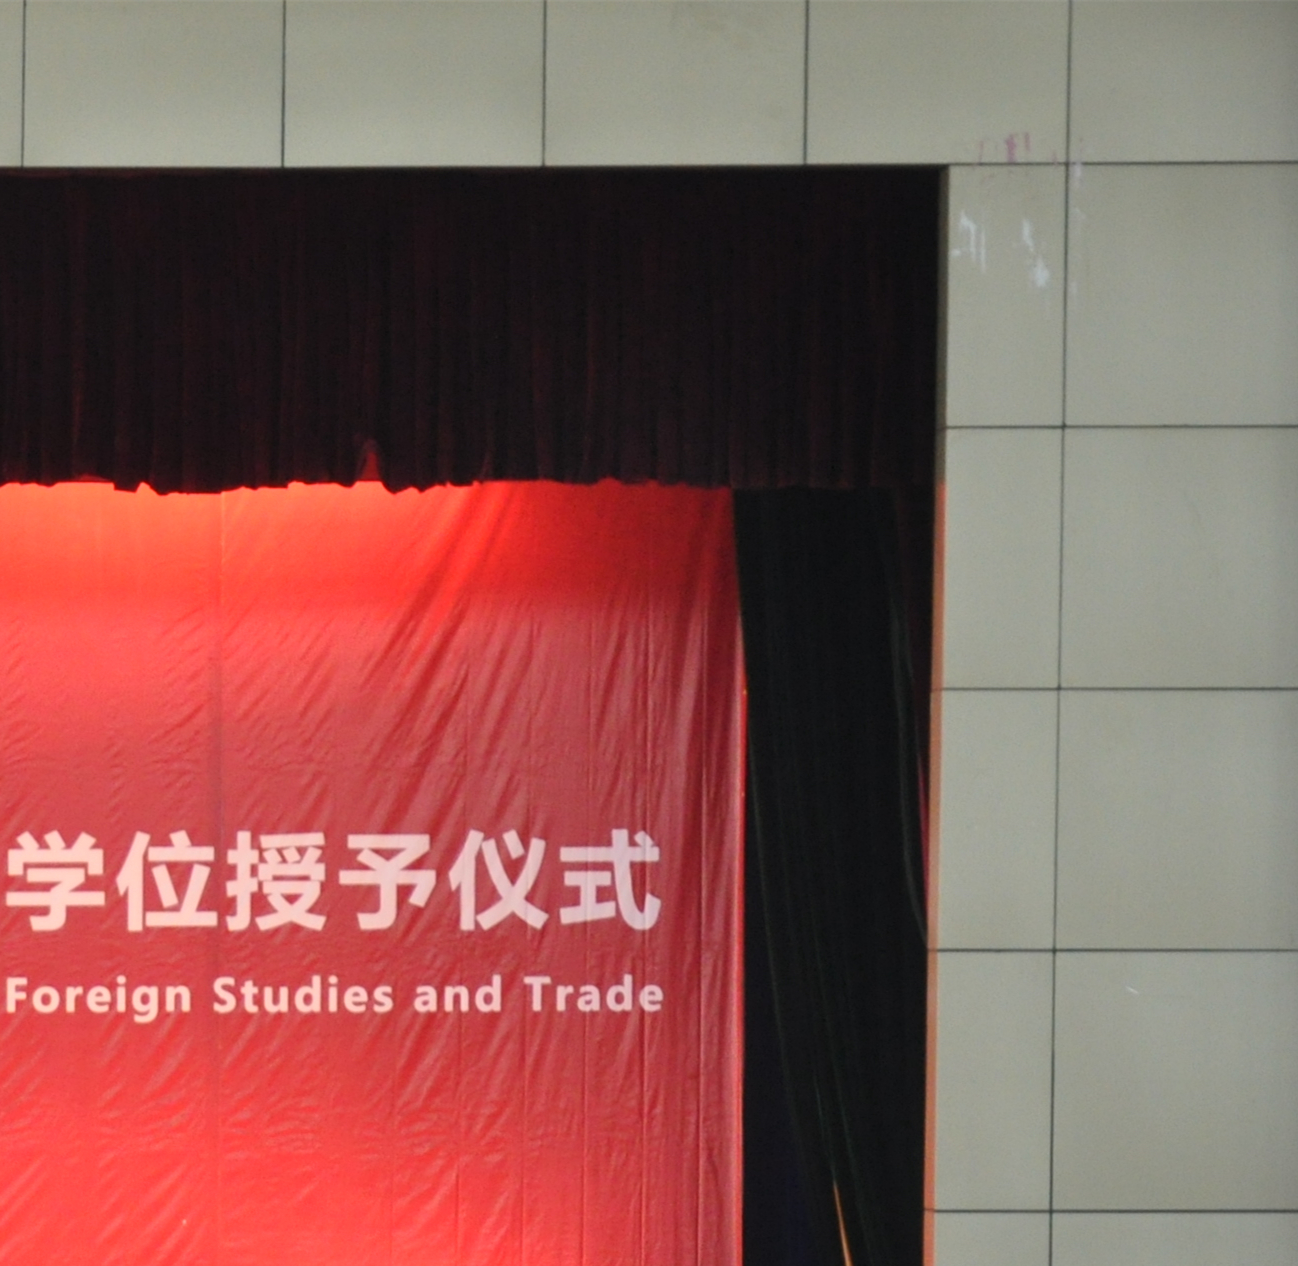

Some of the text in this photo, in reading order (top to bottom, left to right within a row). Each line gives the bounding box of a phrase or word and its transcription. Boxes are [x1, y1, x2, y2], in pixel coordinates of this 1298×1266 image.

[4, 975, 191, 1024] Foreign
[211, 974, 394, 1015] Studies
[412, 974, 503, 1014] and
[523, 974, 664, 1014] Trade
